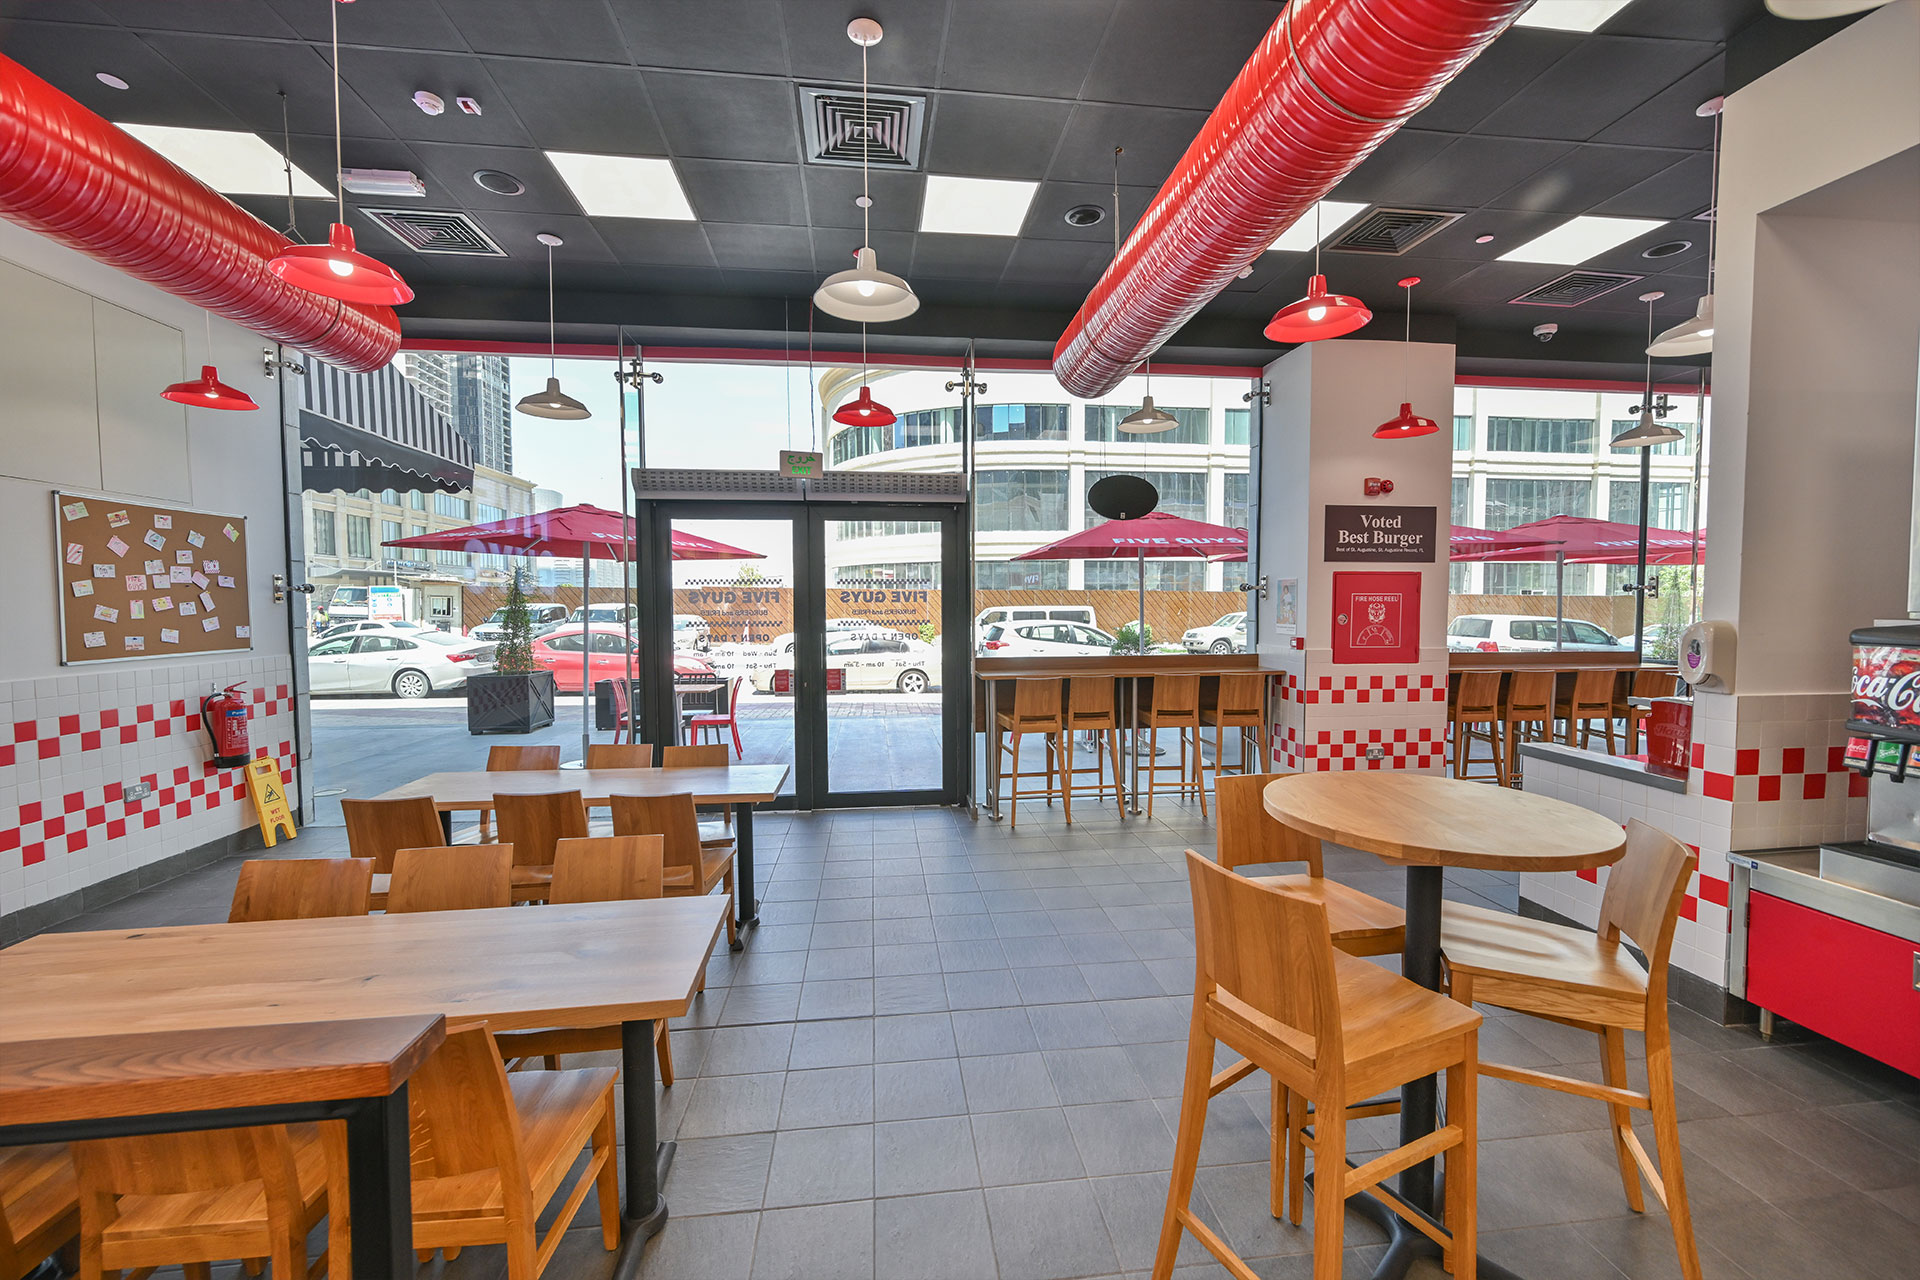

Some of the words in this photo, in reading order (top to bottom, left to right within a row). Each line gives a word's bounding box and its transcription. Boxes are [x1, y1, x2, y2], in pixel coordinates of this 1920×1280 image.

[787, 453, 816, 465] خروج
[791, 466, 812, 475] EXIT
[1360, 514, 1402, 528] Voted
[1338, 530, 1369, 544] Best
[1373, 530, 1423, 547] Burger
[270, 807, 280, 815] WET
[270, 814, 285, 824] FLOOR
